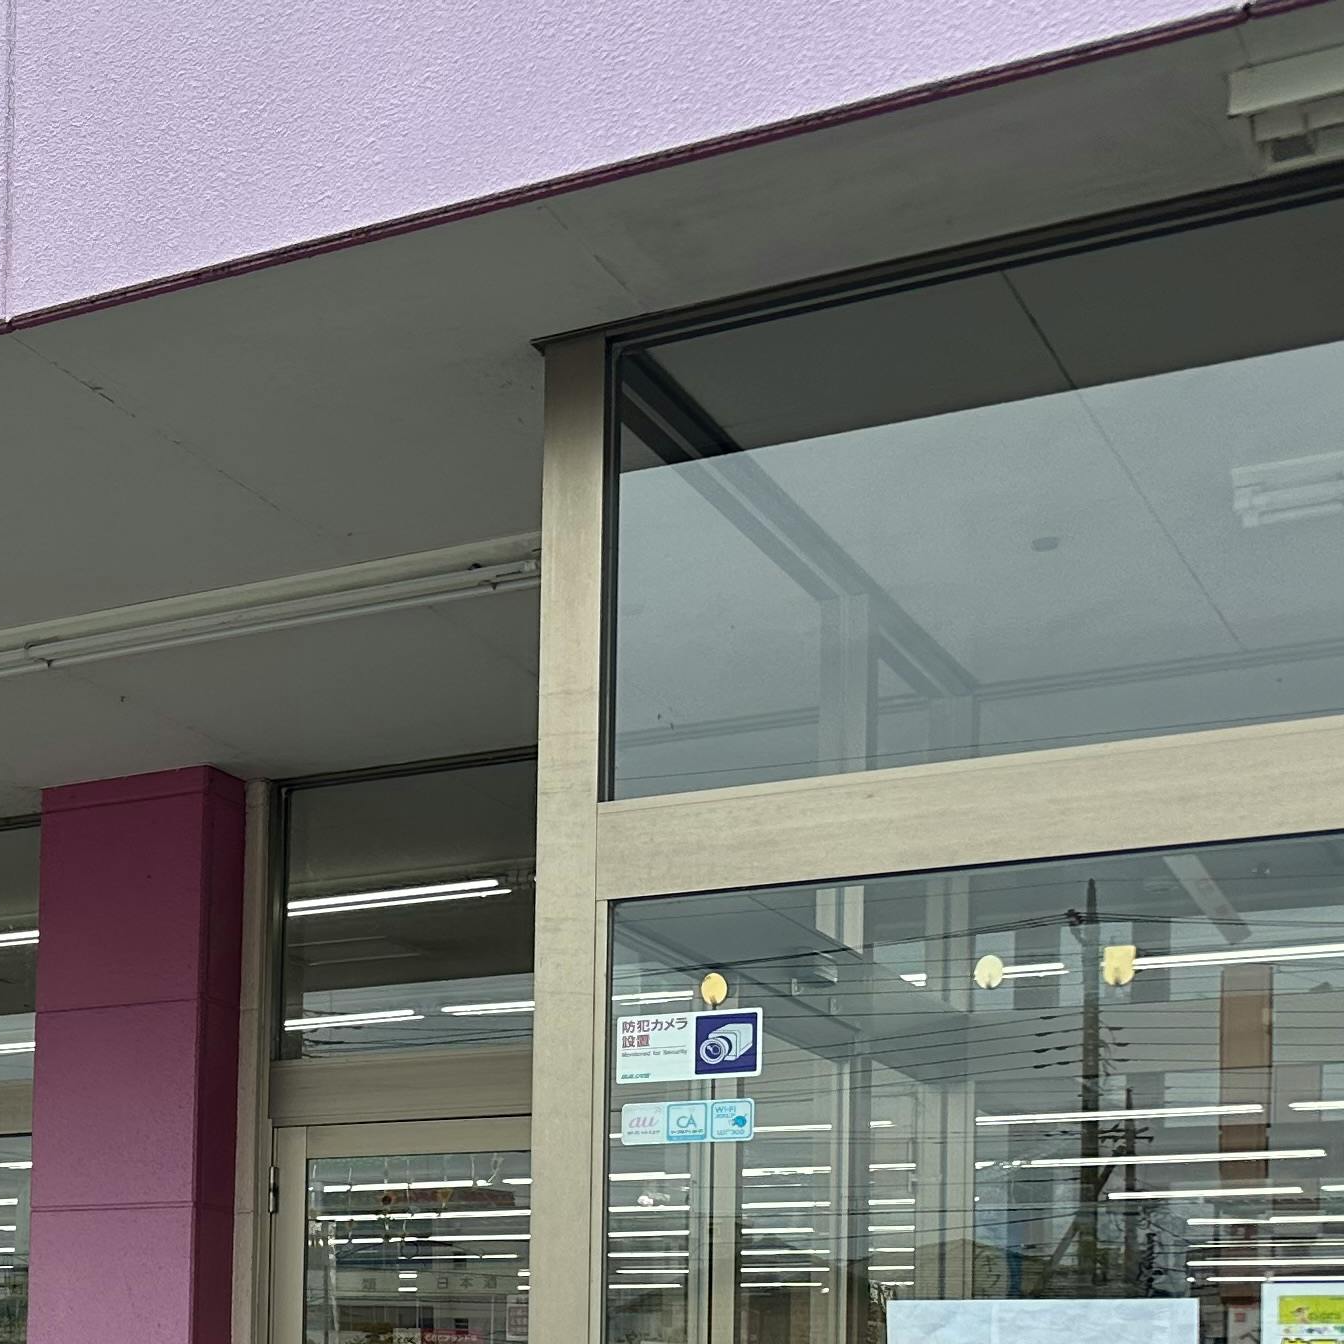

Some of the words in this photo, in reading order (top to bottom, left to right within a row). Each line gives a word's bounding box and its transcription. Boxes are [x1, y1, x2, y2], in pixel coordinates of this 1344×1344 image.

[622, 1017, 688, 1034] 防犯カメラ
[622, 1034, 649, 1048] 設置
[628, 1116, 658, 1129] au
